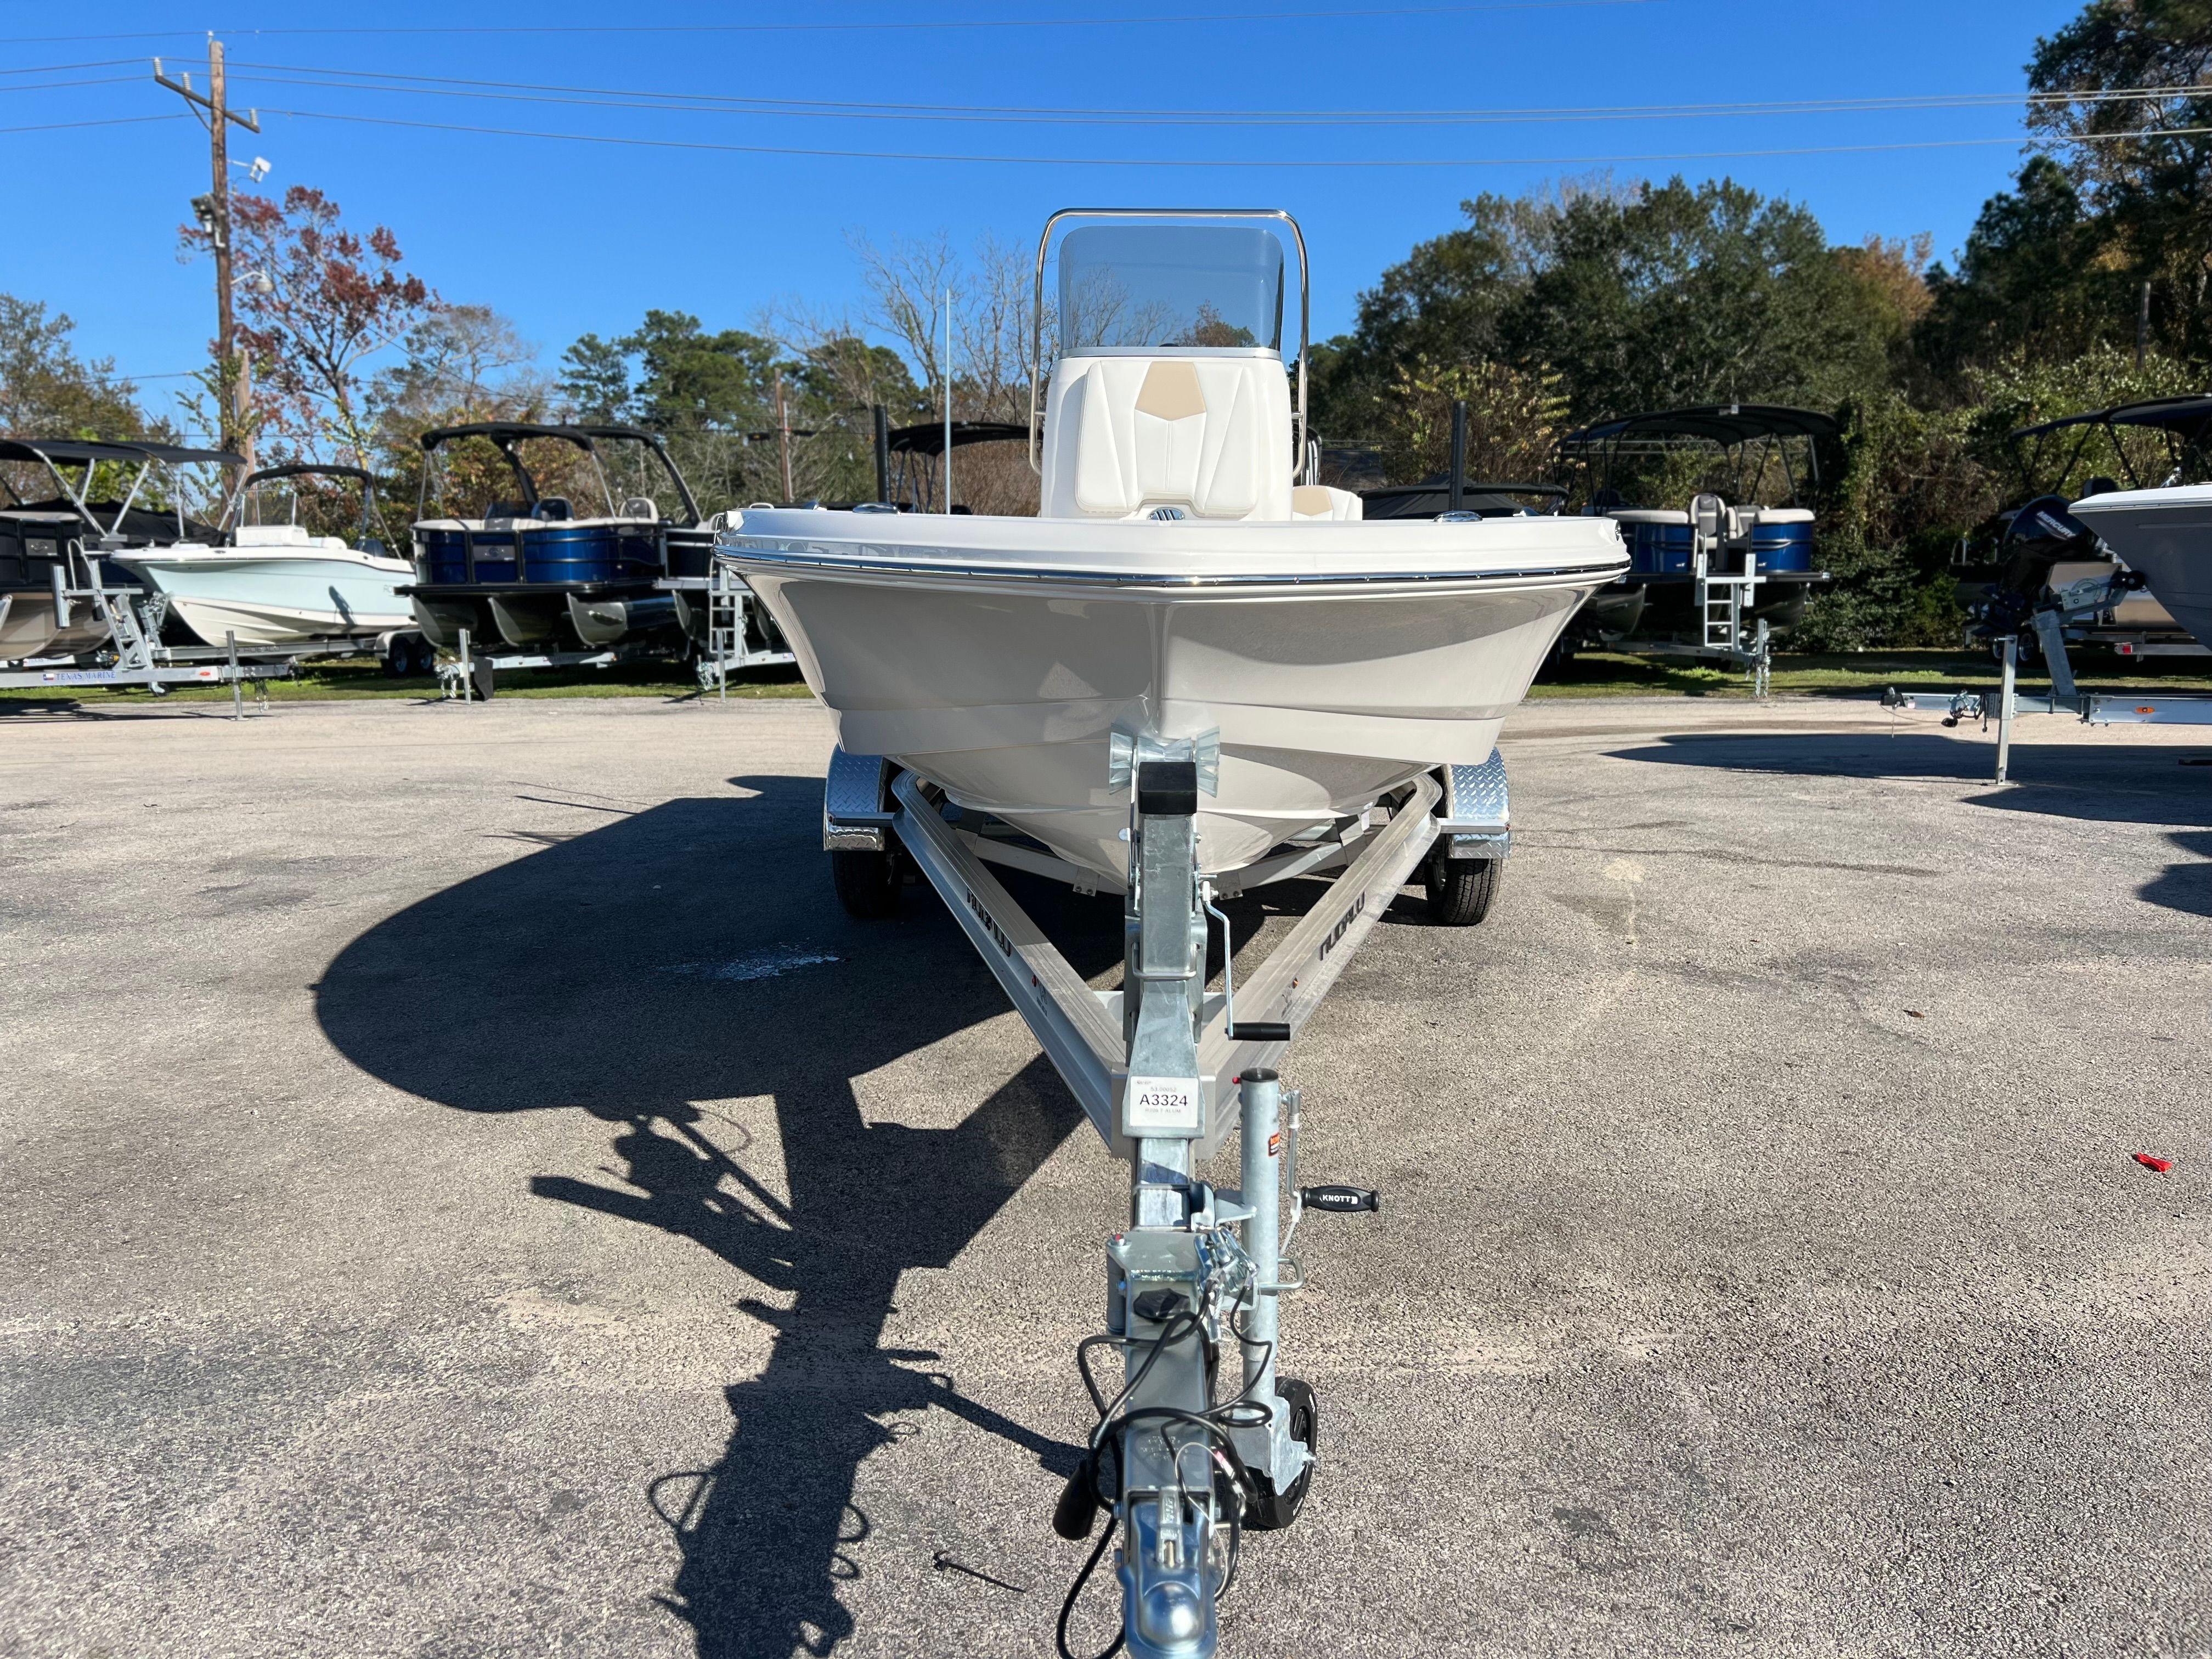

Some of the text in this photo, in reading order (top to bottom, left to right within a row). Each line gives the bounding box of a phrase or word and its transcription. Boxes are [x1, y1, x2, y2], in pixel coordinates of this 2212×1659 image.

[2037, 511, 2076, 537] MERCURY
[85, 671, 116, 679] MARINE
[1139, 1094, 1188, 1106] A3324
[1322, 1194, 1351, 1203] KNOTT
